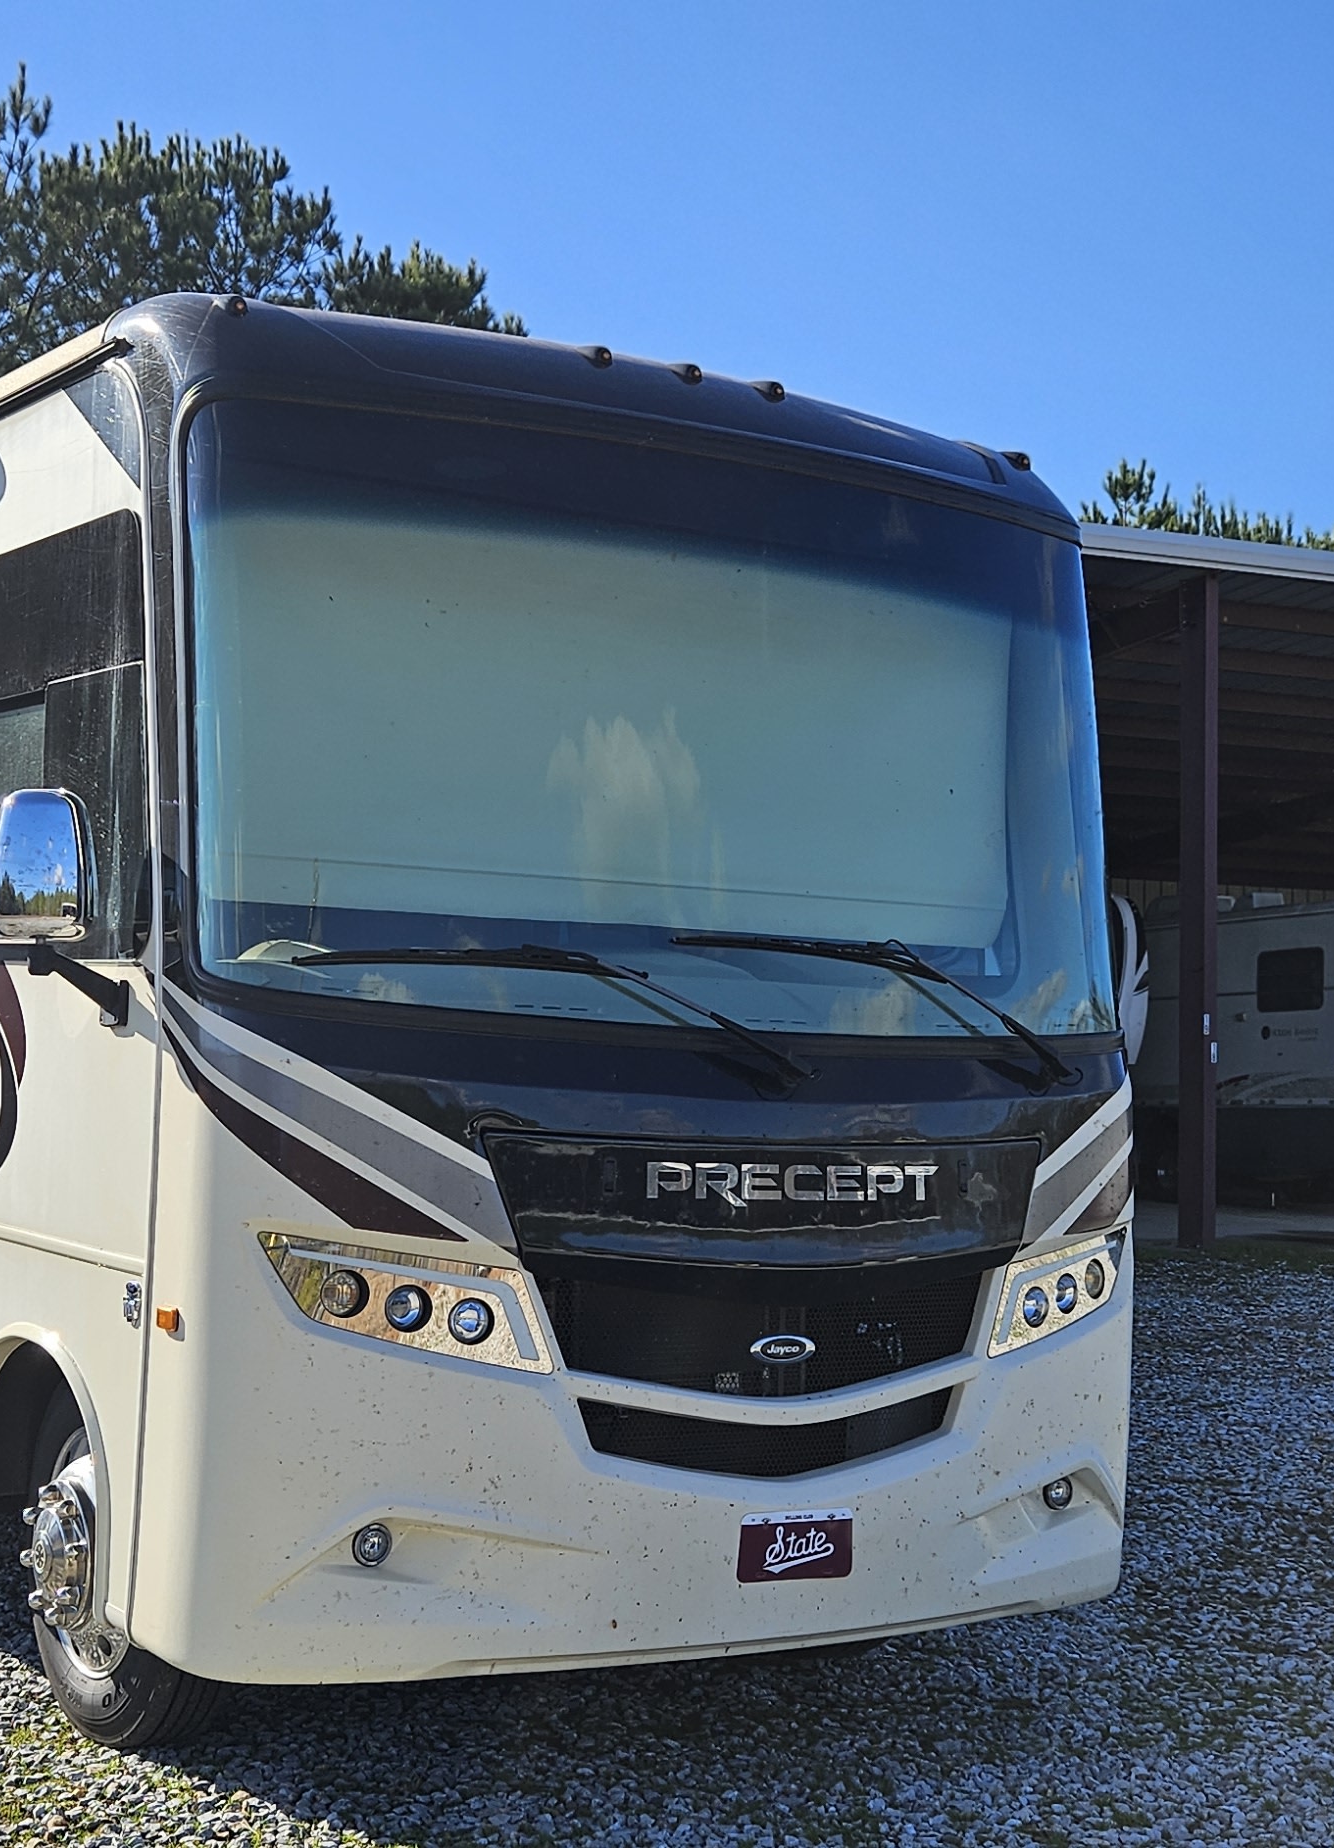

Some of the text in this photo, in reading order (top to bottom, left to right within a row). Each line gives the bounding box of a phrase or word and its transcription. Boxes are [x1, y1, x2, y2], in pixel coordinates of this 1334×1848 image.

[646, 1161, 940, 1208] PRECEPT
[767, 1343, 800, 1356] Jayco
[763, 1525, 831, 1568] State
